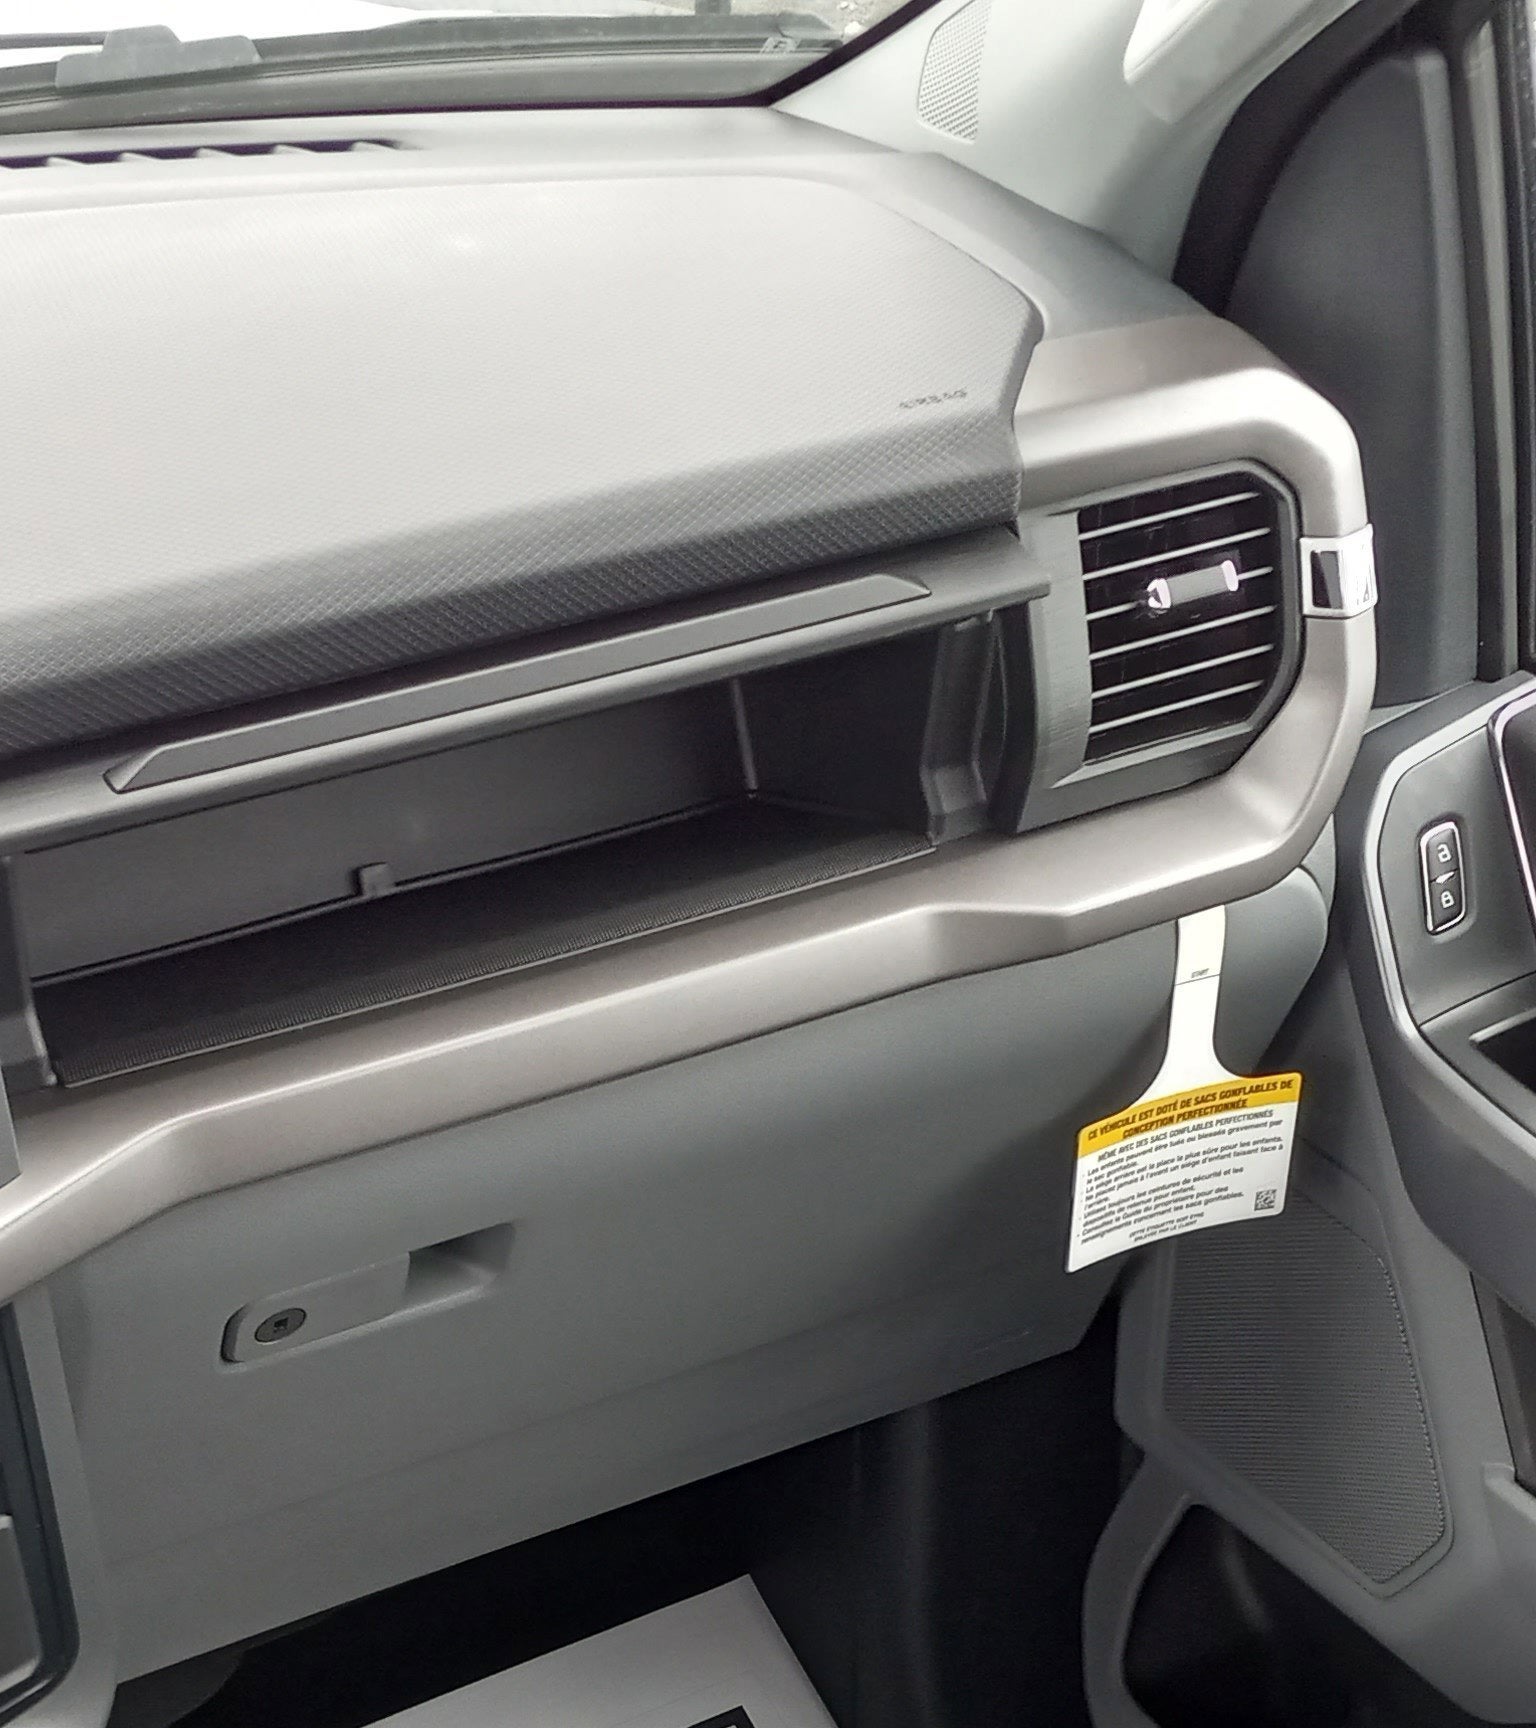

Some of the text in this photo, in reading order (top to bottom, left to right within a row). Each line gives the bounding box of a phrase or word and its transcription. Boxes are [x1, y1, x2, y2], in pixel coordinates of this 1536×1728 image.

[1138, 1107, 1155, 1122] EST
[1156, 1098, 1179, 1116] DOTÉ
[1180, 1097, 1194, 1109] DE
[1194, 1091, 1218, 1105] SACS
[1280, 1079, 1294, 1090] DE
